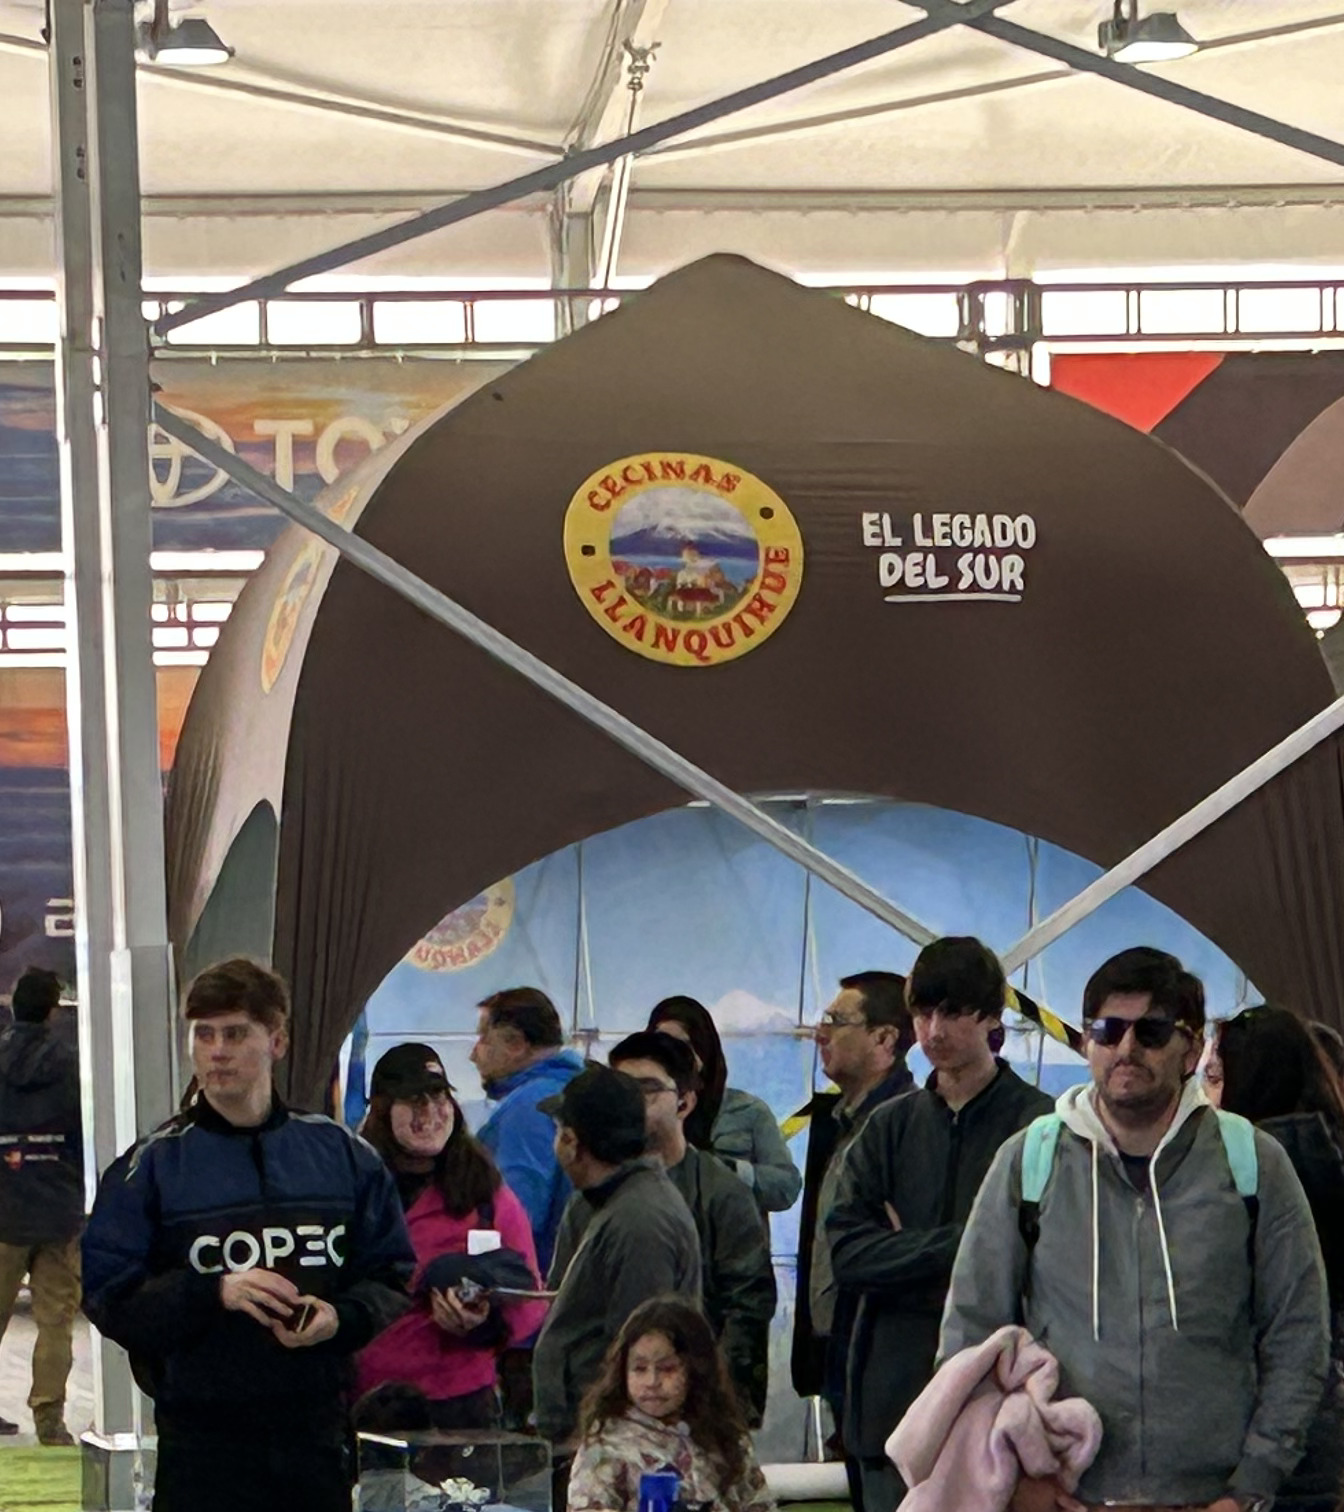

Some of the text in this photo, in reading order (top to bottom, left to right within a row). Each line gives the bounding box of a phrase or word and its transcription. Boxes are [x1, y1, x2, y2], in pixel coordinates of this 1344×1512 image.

[587, 459, 742, 512] CECINAS
[862, 512, 1037, 549] EL LEGADO
[879, 552, 1025, 591] DEL SUR
[590, 546, 790, 664] LLANQUIHUE
[188, 1225, 347, 1274] COPEC
